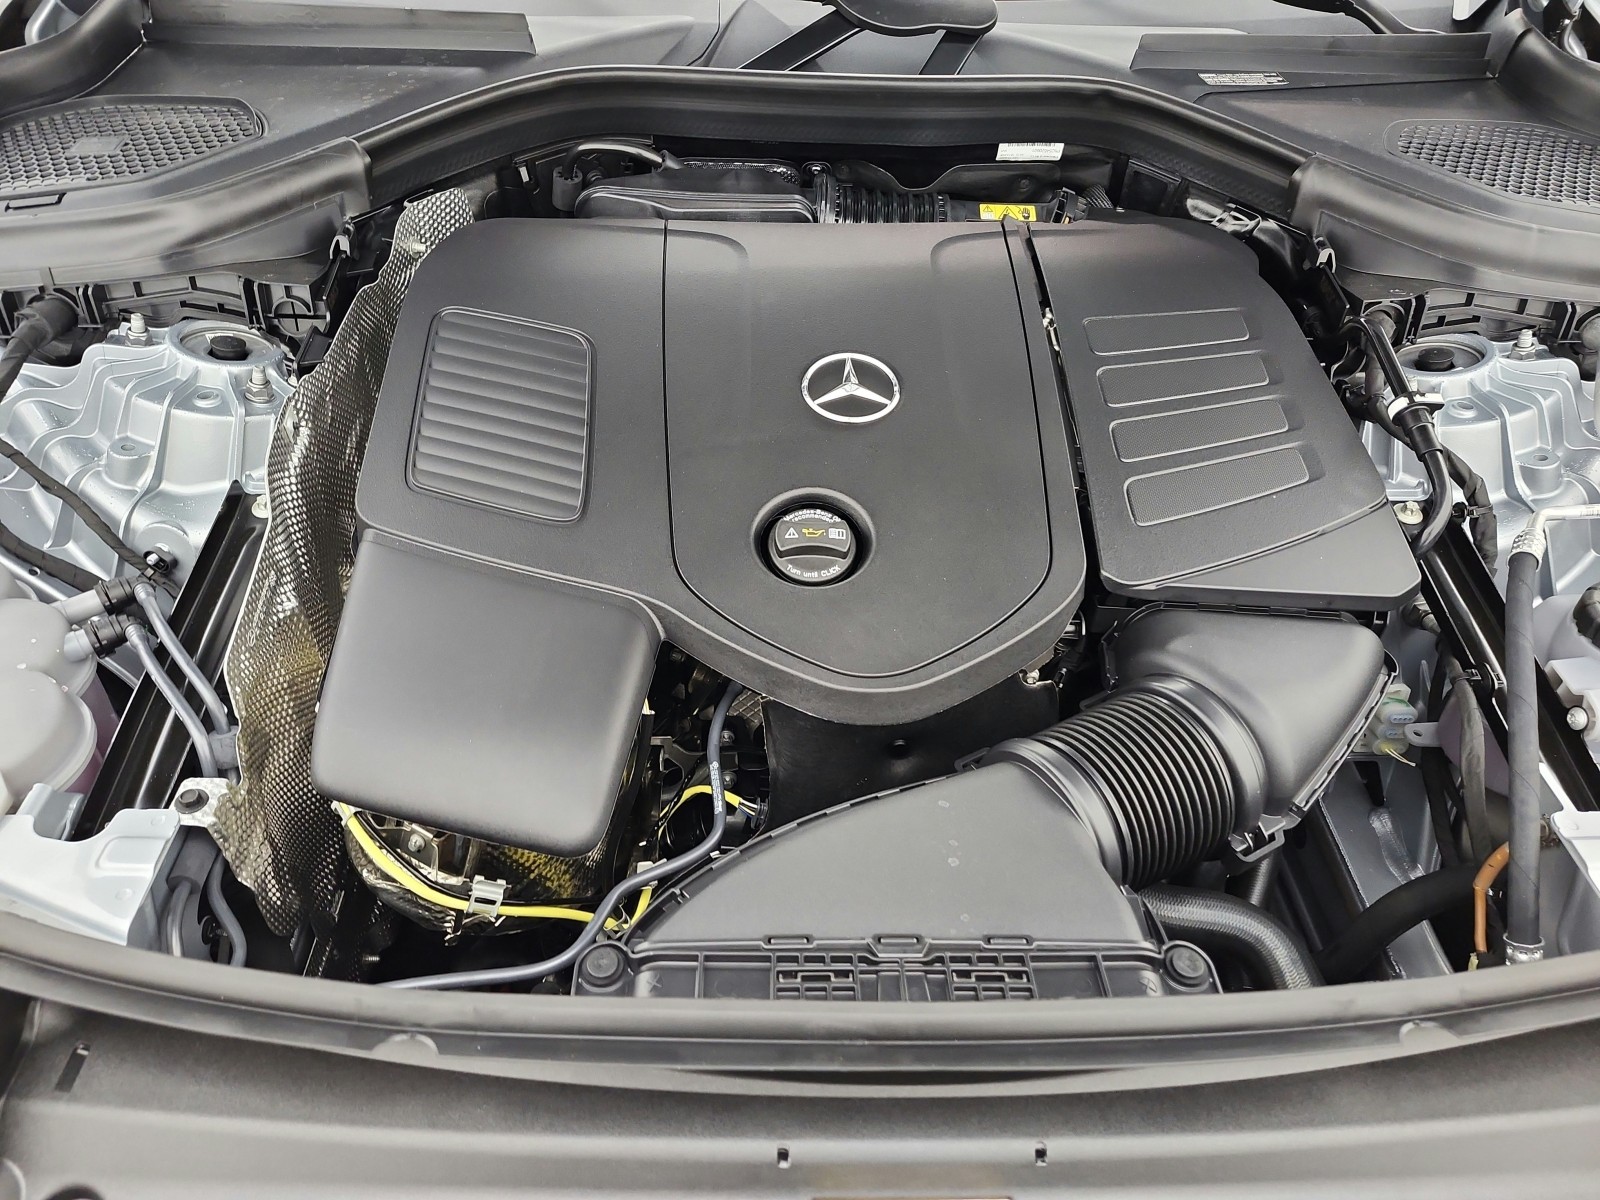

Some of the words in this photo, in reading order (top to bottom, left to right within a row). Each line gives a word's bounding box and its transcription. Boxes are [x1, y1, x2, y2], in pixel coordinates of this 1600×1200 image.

[786, 564, 801, 575] Turn
[803, 570, 819, 578] until
[820, 565, 841, 577] CLICK
